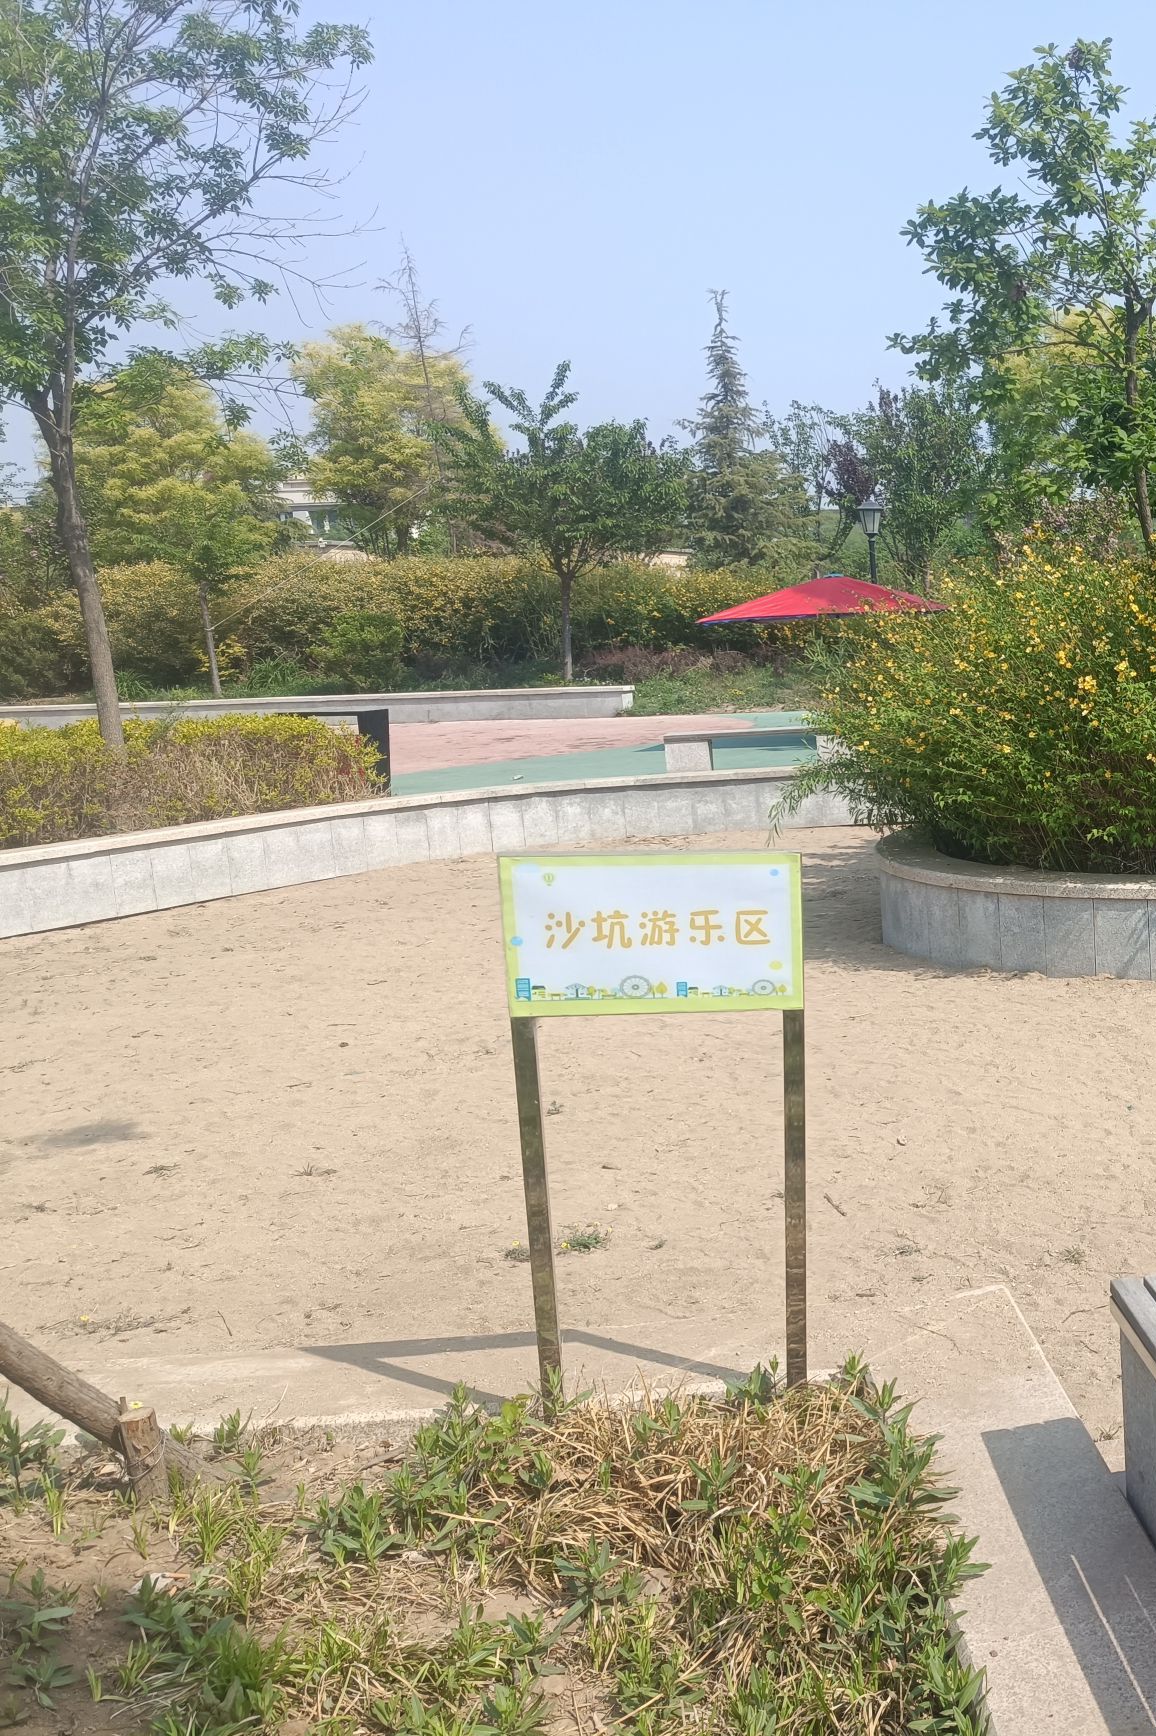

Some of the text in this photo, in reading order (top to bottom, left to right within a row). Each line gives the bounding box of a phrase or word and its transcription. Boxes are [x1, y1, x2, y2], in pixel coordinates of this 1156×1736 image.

[545, 909, 770, 949] 沙坑游乐区
